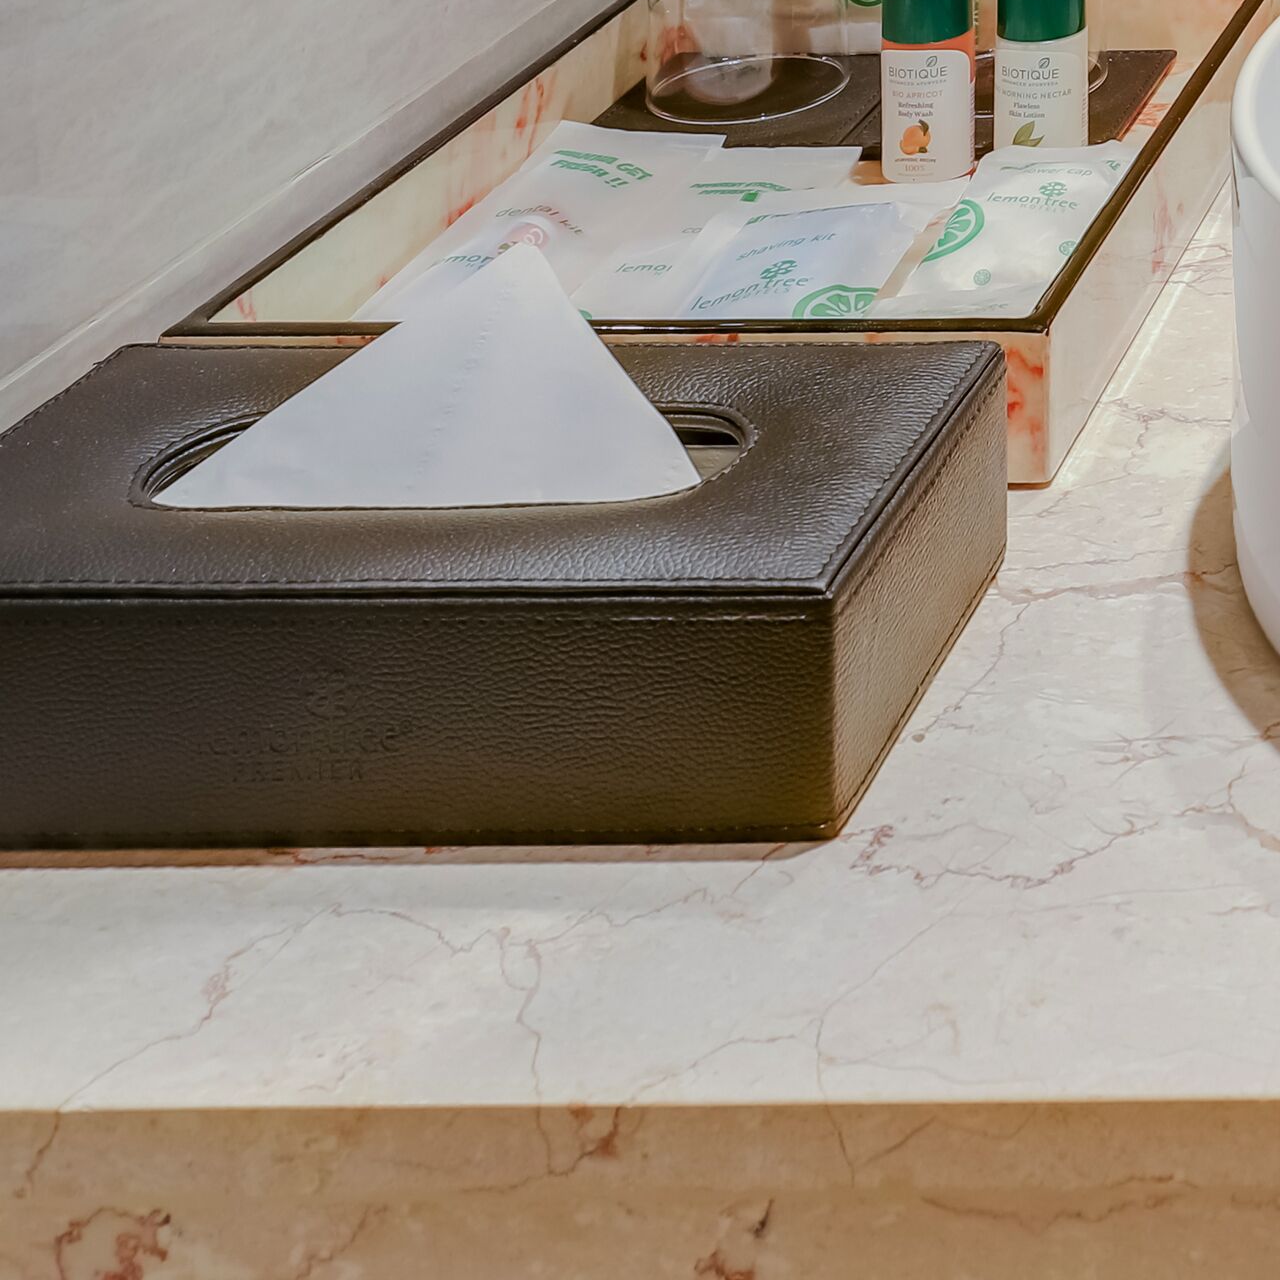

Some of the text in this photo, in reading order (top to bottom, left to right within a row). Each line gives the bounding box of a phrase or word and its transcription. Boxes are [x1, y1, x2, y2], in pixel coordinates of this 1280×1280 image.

[888, 65, 948, 80] BIOTIQUE
[1001, 66, 1060, 81] BIOTIQUE
[1040, 88, 1073, 100] NECTAR
[616, 163, 653, 180] GET
[986, 191, 1078, 210] lemon tree
[496, 204, 583, 234] dental kit
[736, 232, 837, 261] shaving kit
[690, 277, 809, 311] lemon tree
